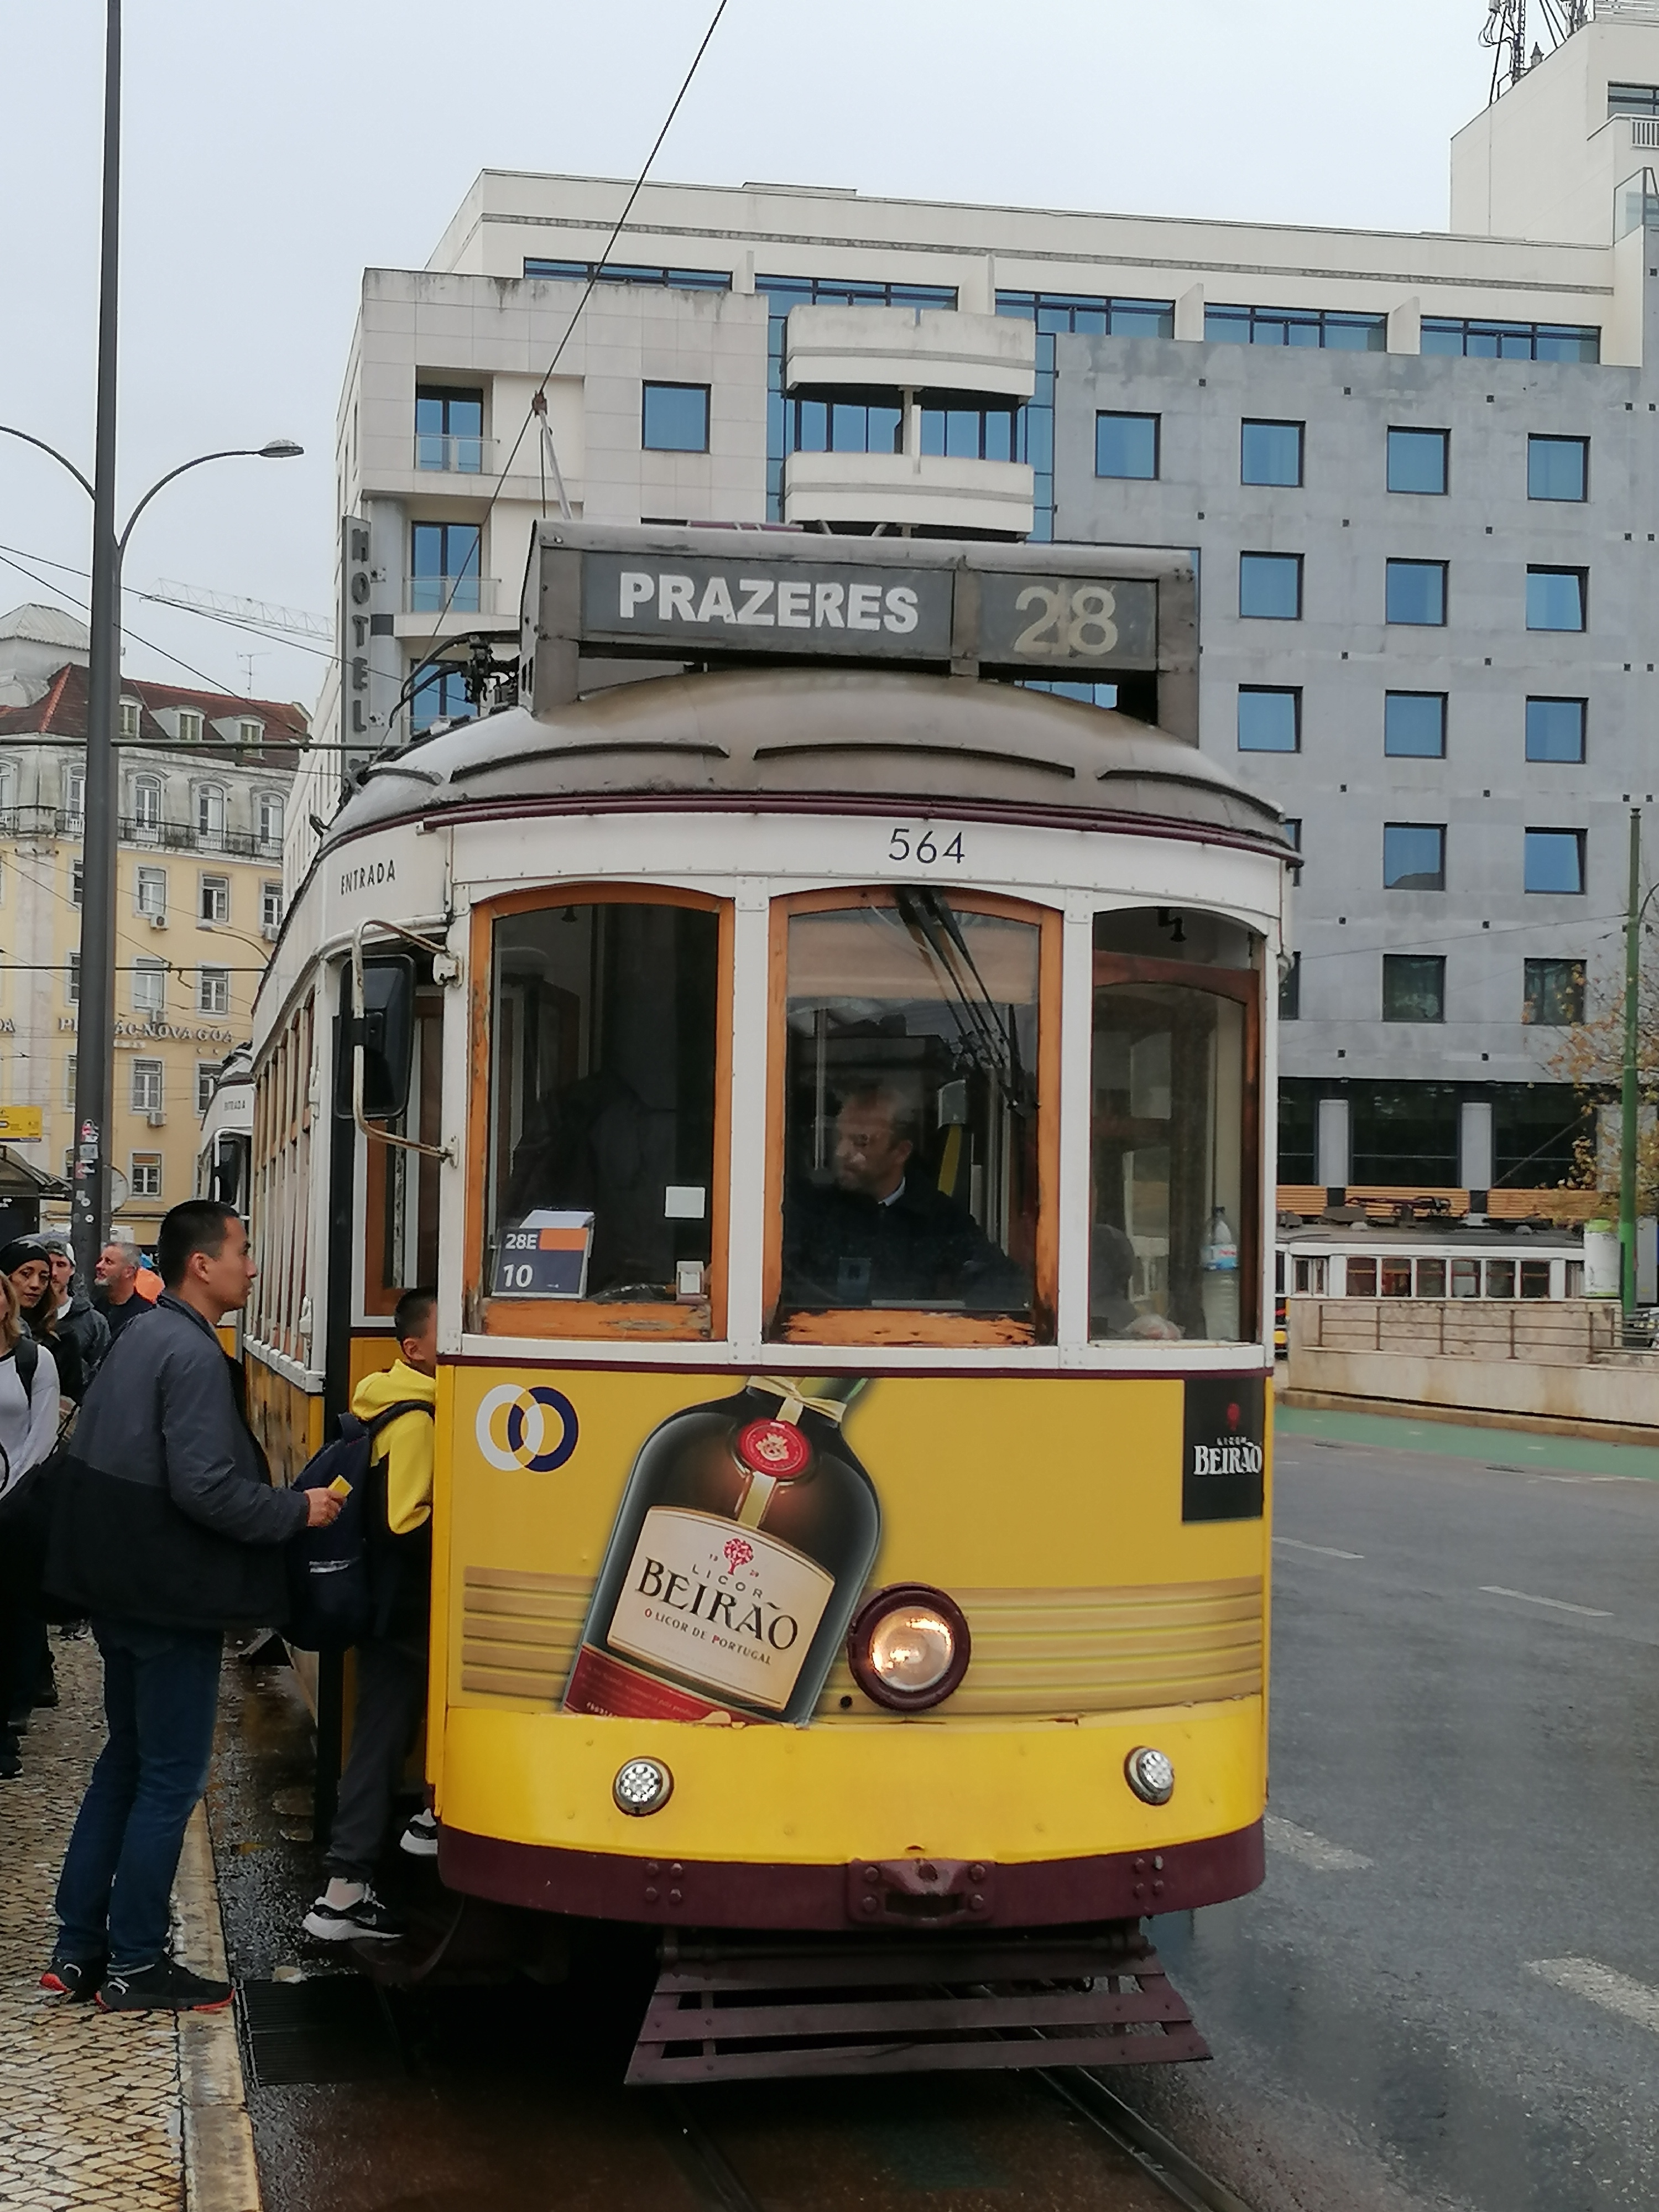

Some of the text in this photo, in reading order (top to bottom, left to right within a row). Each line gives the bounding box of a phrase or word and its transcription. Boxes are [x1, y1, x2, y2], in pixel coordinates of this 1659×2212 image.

[619, 571, 919, 634] PRAZERES
[1013, 584, 1118, 657] 28
[352, 528, 370, 733] HOTEL
[889, 828, 965, 864] 564
[341, 859, 395, 896] ENTRADA
[505, 1233, 538, 1250] 28E
[503, 1264, 533, 1287] 10
[1193, 1442, 1262, 1475] BEIRÃO
[691, 1563, 763, 1599] LICOR
[635, 1556, 799, 1651] BEIRÃO
[655, 1611, 688, 1632] LICOR
[692, 1626, 707, 1640] DE
[711, 1635, 771, 1666] PORTUGAL
